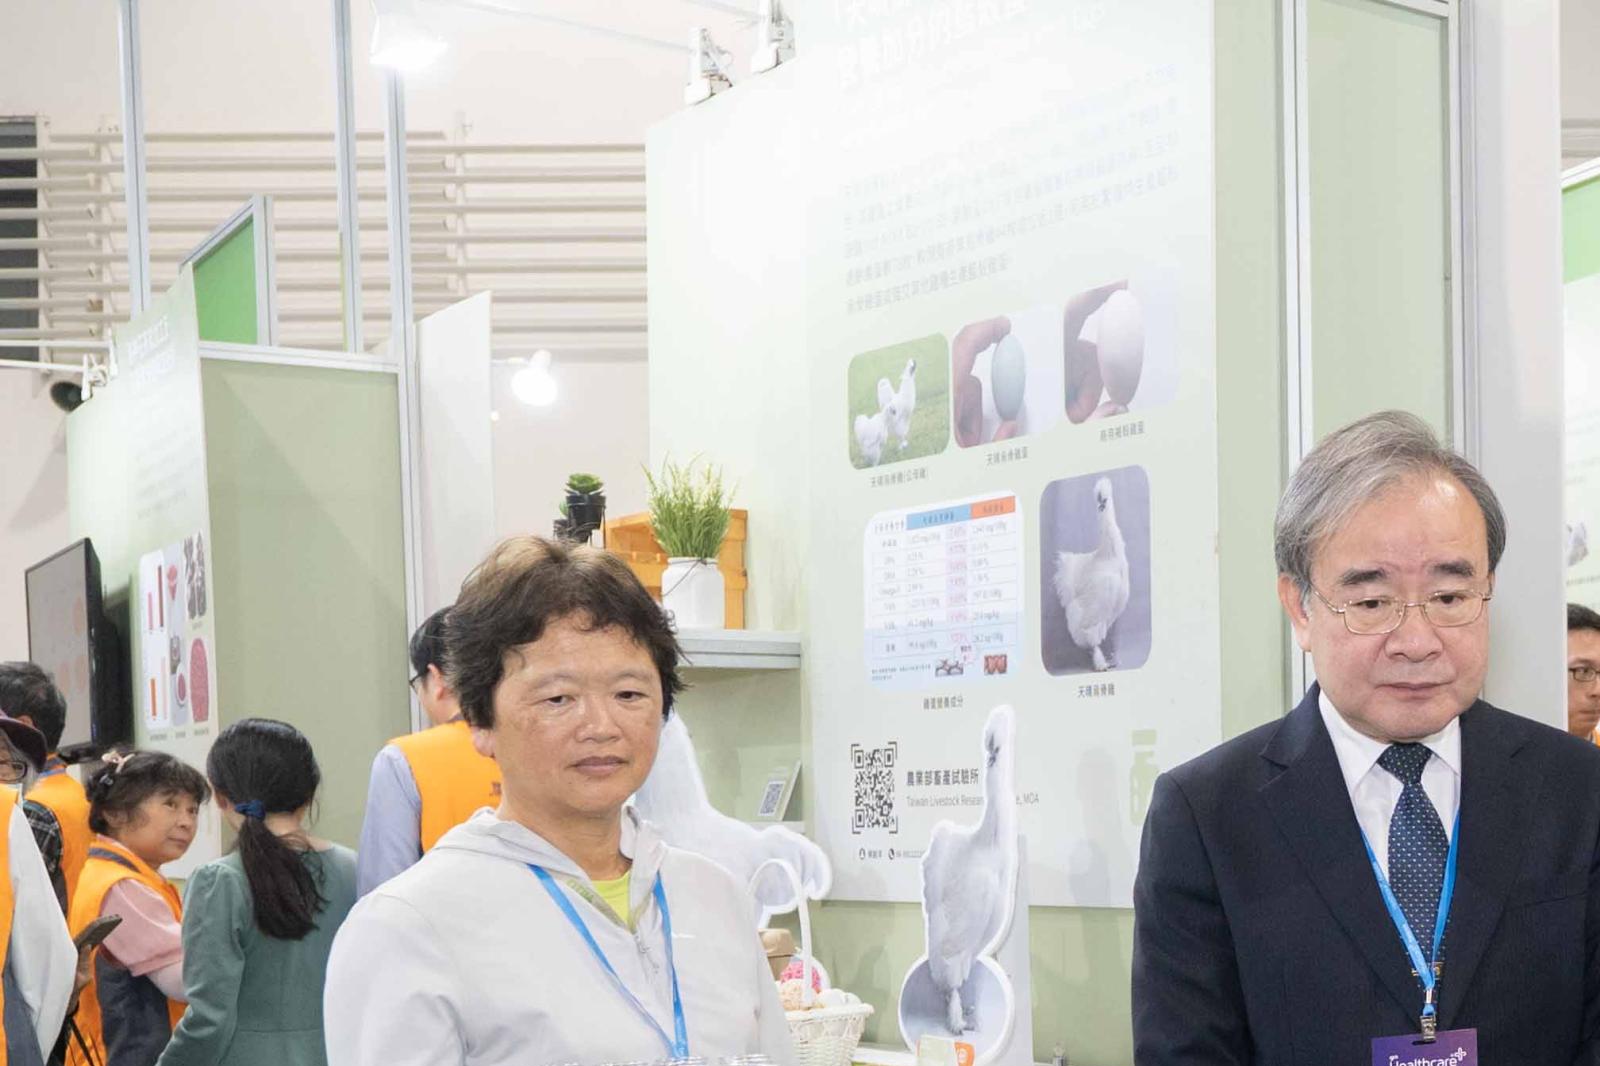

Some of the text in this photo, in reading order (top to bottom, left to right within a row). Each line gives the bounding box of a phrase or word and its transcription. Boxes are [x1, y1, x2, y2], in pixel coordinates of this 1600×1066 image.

[906, 769, 979, 786] 農業部畜產試驗所
[906, 796, 928, 807] Taiwan
[930, 795, 959, 806] Livestock
